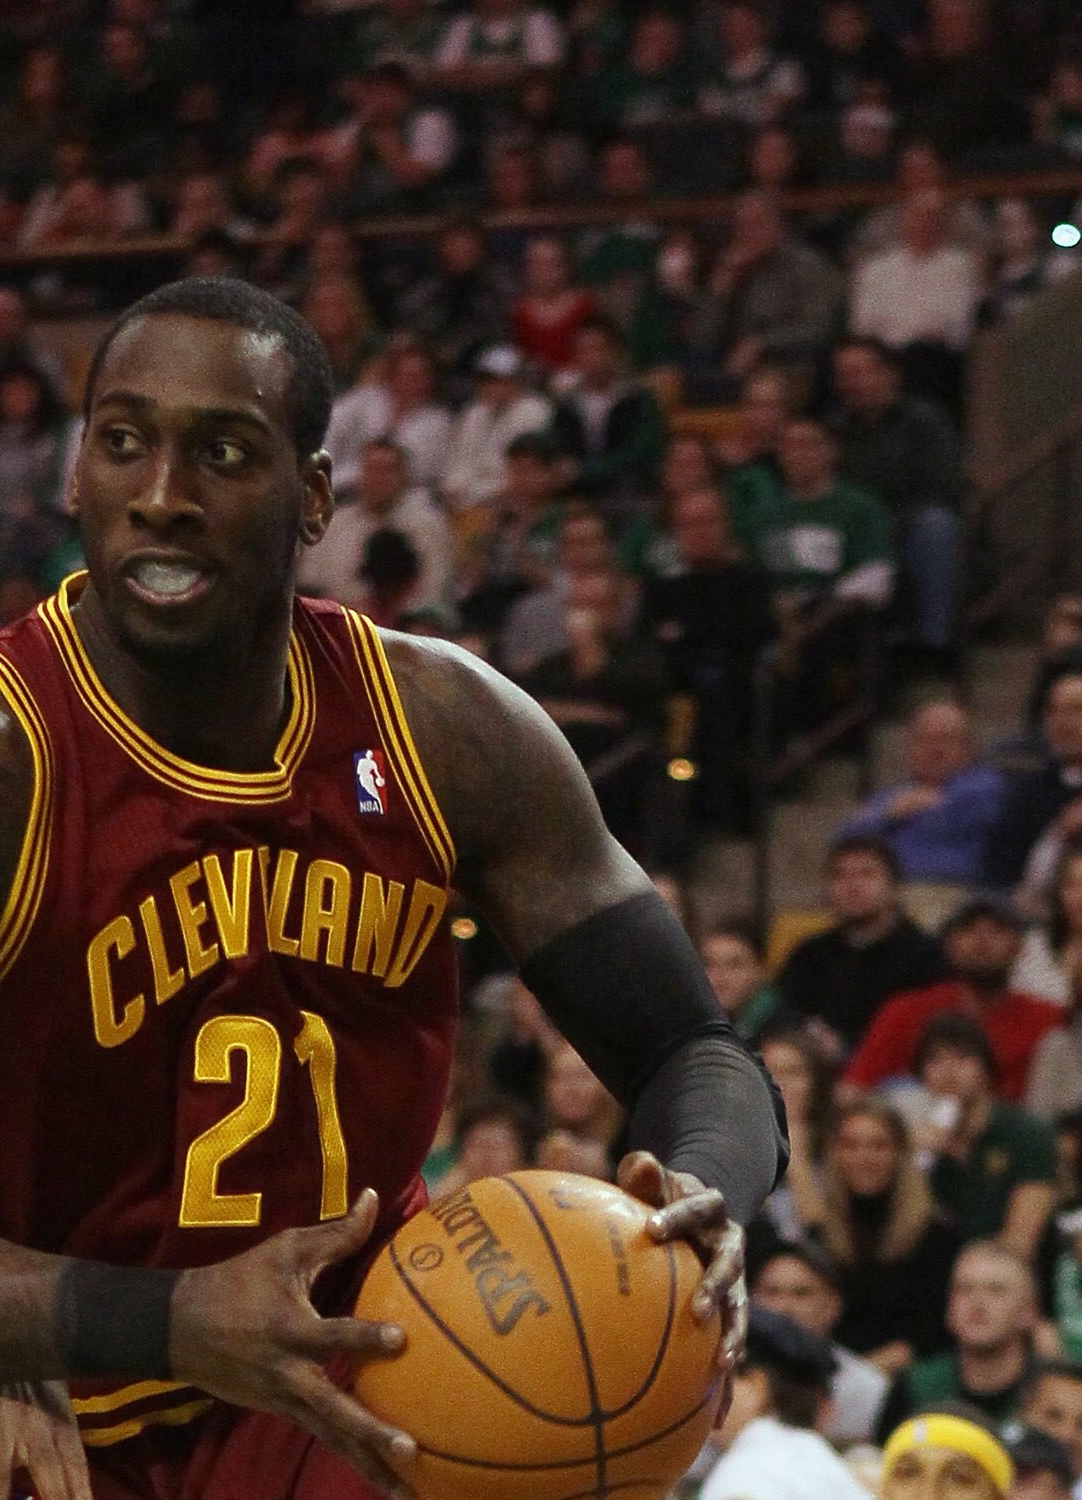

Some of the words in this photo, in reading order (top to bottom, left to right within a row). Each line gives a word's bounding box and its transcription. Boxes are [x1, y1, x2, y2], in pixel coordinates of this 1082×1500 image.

[359, 800, 380, 813] NBA
[85, 845, 449, 1049] CLEVLAND
[177, 1008, 349, 1229] 21
